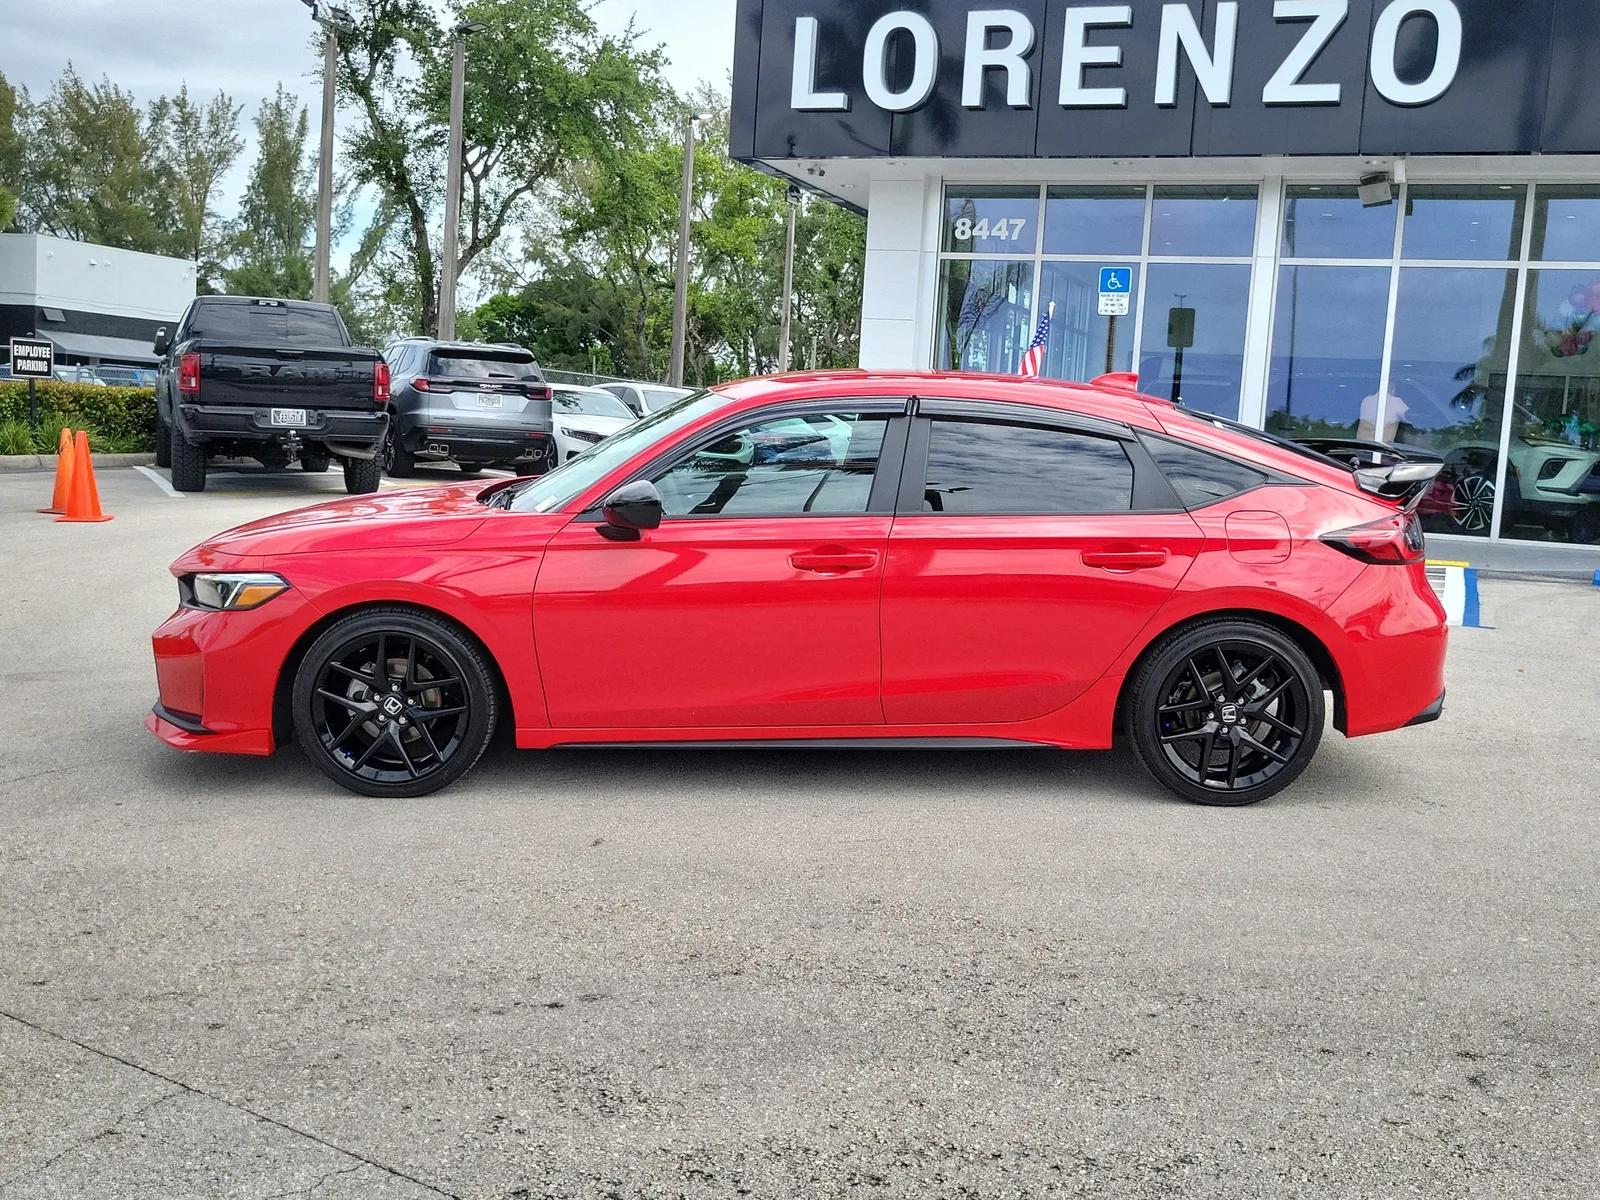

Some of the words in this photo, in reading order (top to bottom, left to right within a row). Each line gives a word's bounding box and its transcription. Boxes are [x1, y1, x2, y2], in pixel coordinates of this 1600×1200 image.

[791, 0, 1463, 112] LORENZO
[954, 217, 1026, 241] 8447
[13, 344, 51, 359] EMPLOYEE
[16, 359, 48, 372] PARKING
[241, 364, 336, 381] RAM
